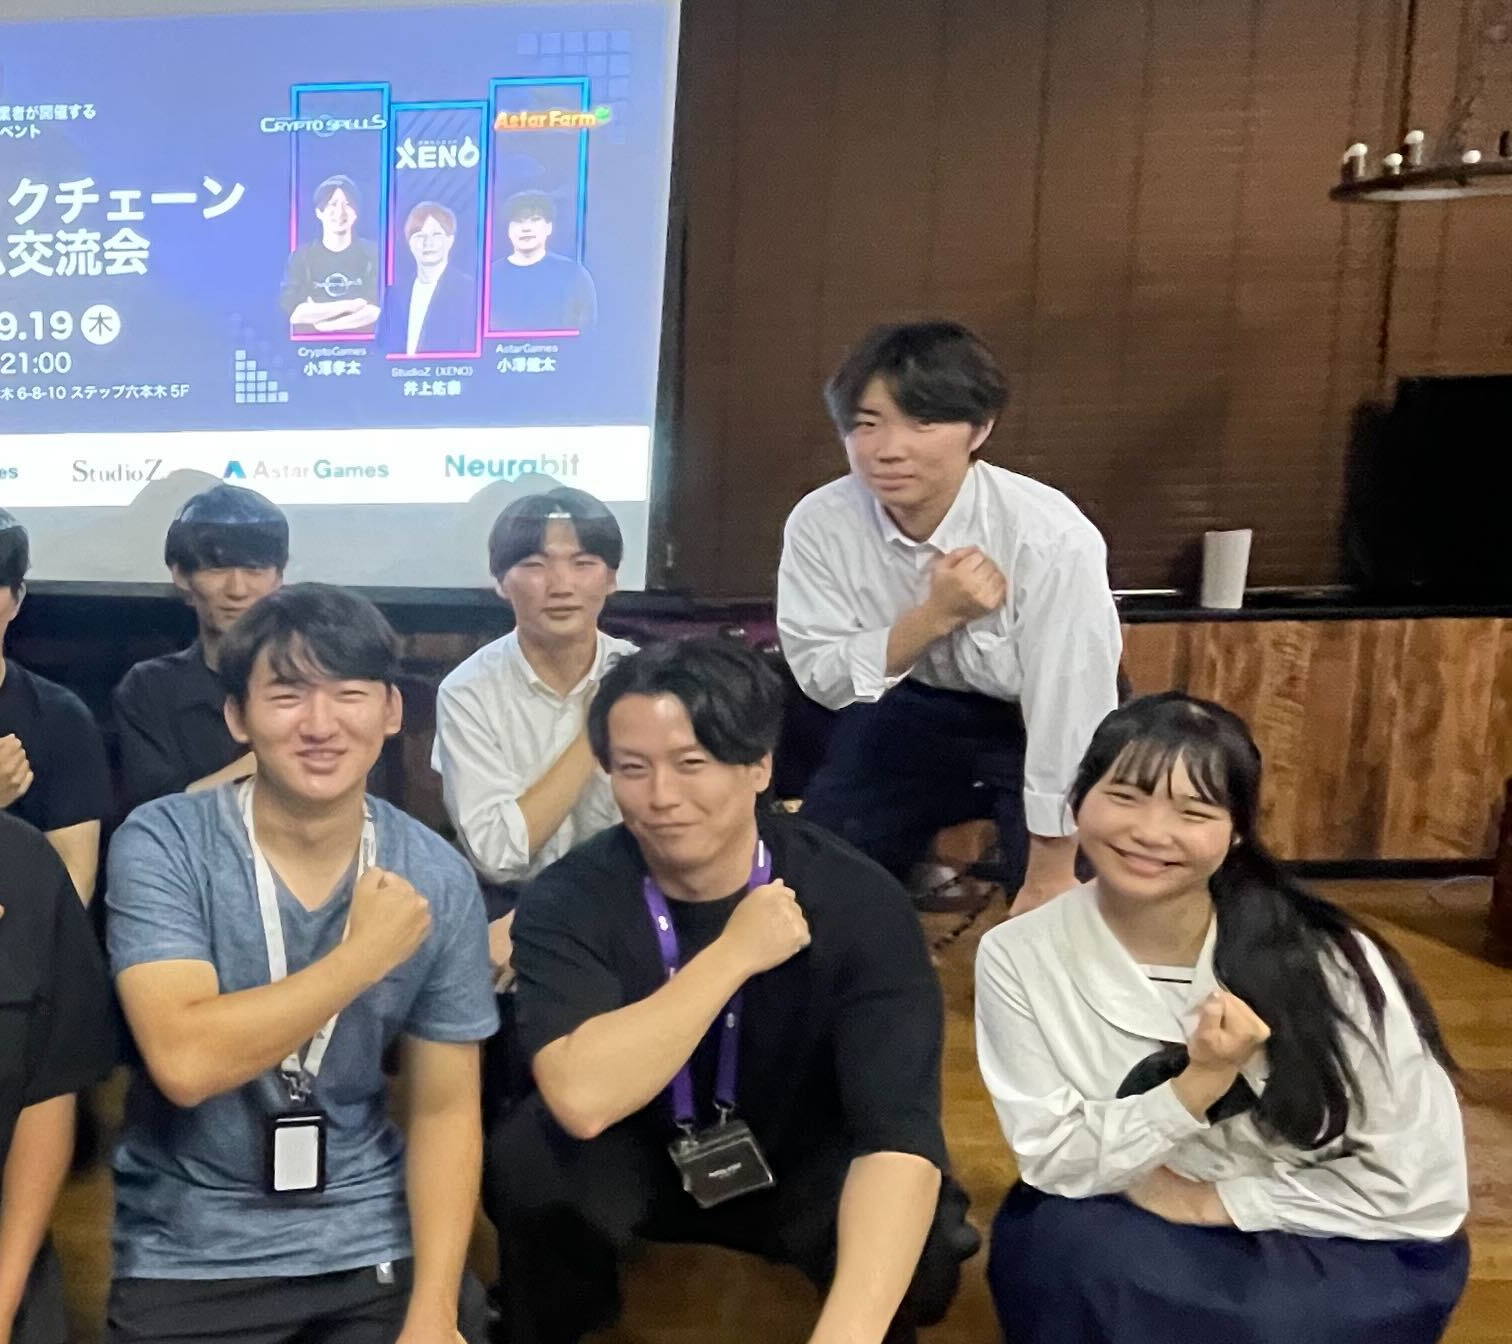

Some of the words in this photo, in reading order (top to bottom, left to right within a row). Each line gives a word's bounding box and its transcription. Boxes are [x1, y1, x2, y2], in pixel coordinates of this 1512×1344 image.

[495, 111, 547, 131] Astar
[548, 109, 597, 130] Farm
[395, 136, 480, 169] XENO
[0, 351, 73, 375] 21:00
[16, 385, 67, 401] 6-8-10
[71, 384, 168, 400] ステップ六本木
[170, 383, 190, 399] 5F
[71, 458, 164, 483] StudioZ
[313, 458, 390, 479] Games
[444, 453, 580, 478] Neurabit
